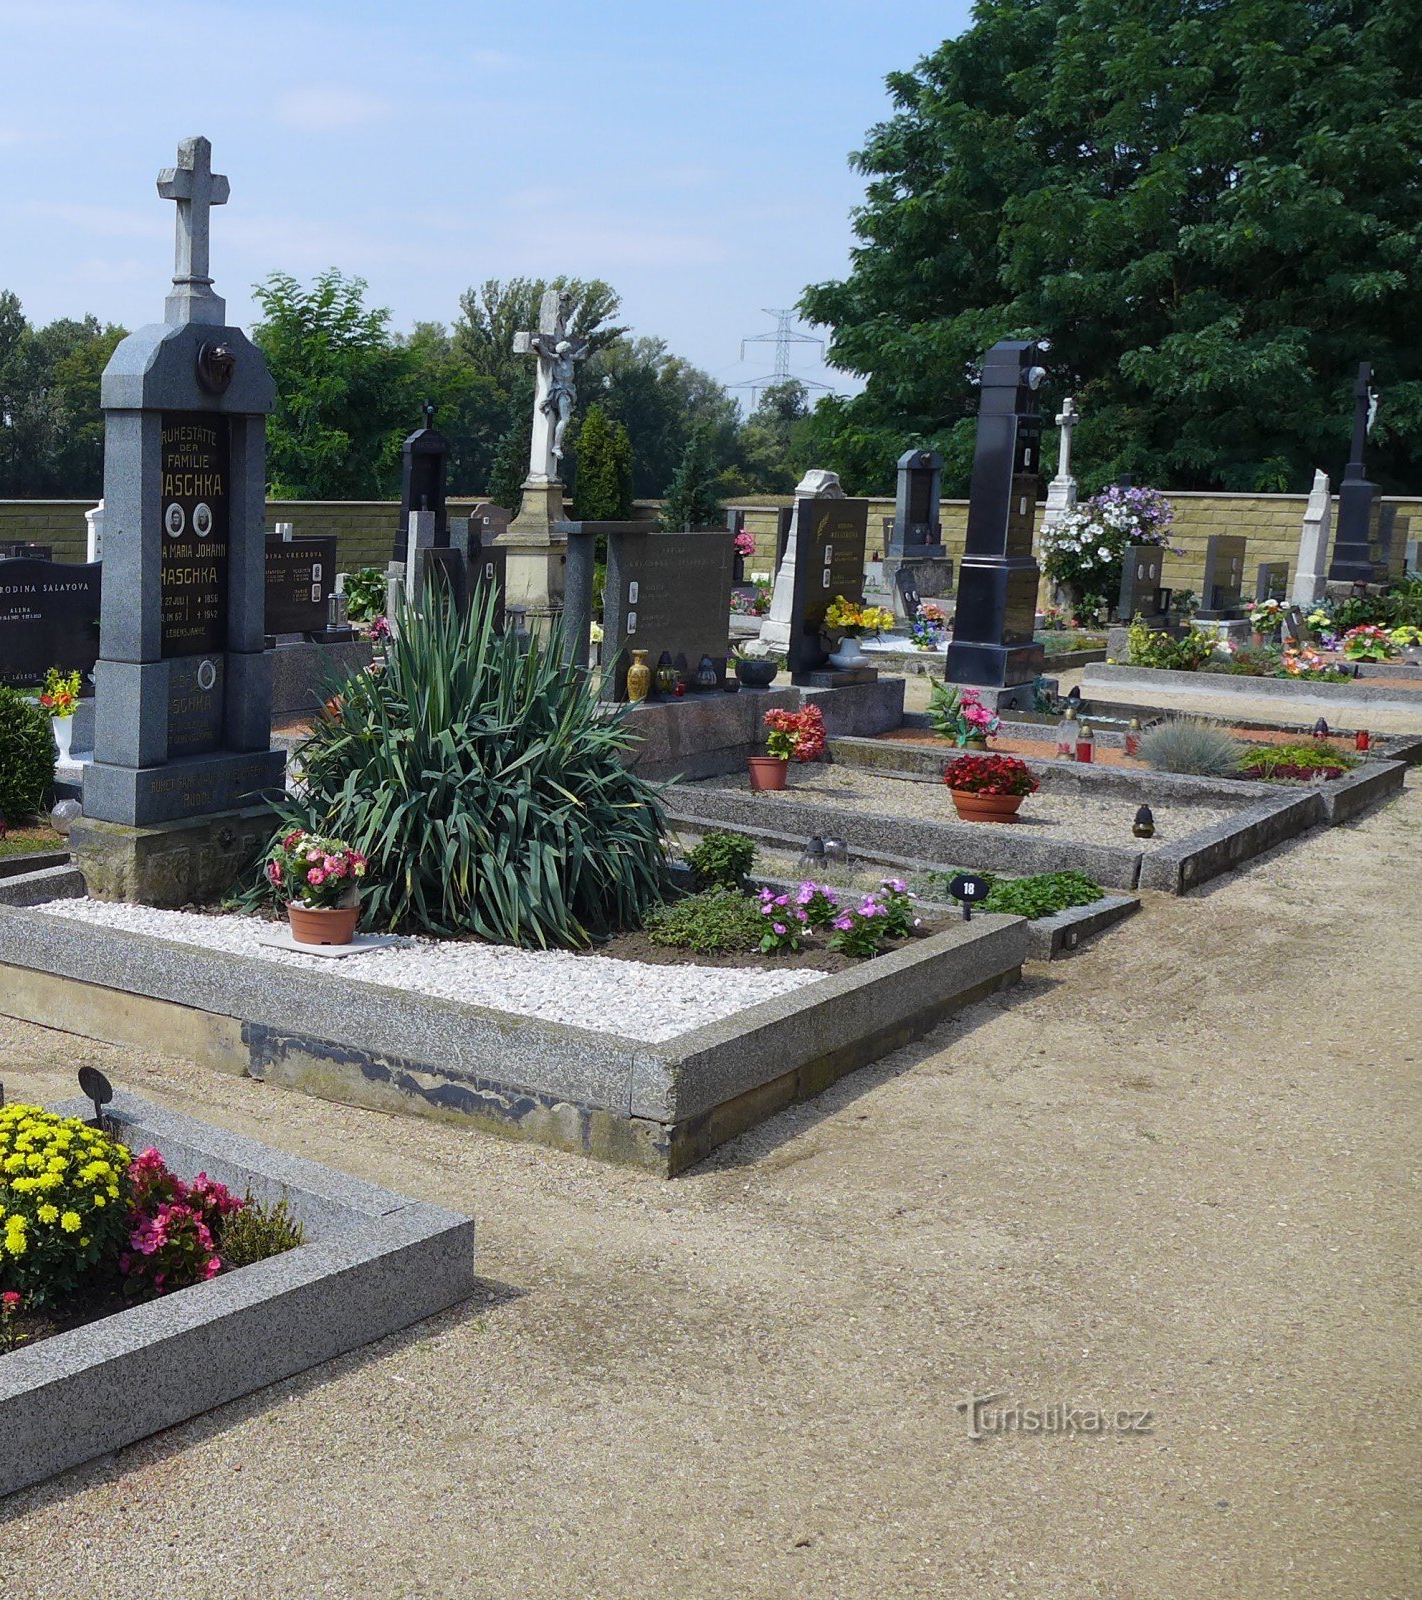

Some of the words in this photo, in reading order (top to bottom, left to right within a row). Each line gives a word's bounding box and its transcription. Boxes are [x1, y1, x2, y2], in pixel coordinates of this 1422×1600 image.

[179, 443, 198, 452] DER
[167, 454, 210, 468] FAMILIE
[169, 544, 193, 558] MARIA
[195, 542, 226, 558] JOHANN
[0, 585, 36, 594] RODINA
[43, 582, 89, 592] SALAYOVA
[963, 882, 975, 895] 18
